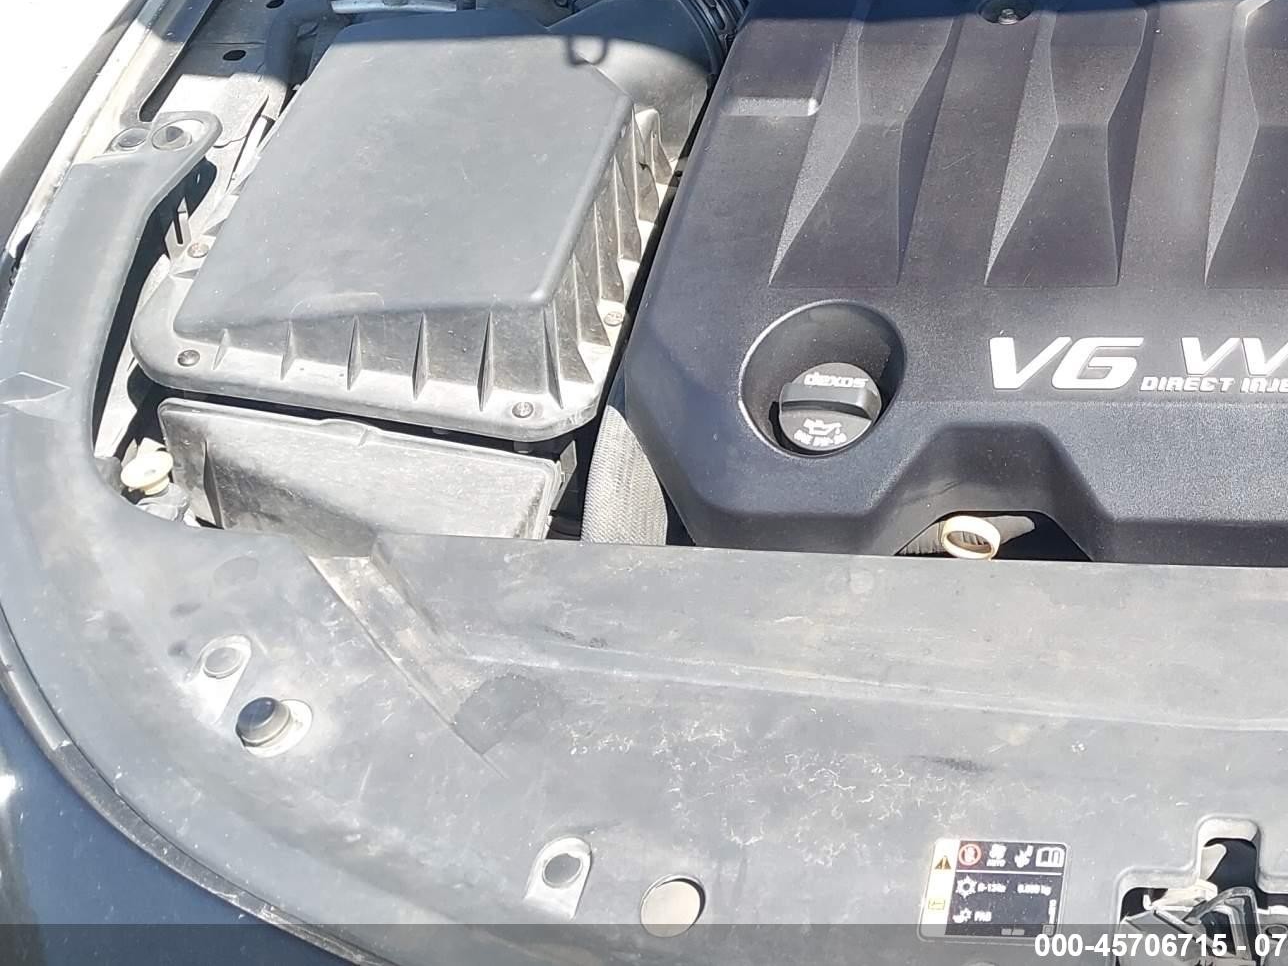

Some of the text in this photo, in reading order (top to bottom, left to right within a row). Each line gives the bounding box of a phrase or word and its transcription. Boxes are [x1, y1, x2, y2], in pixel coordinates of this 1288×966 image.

[989, 336, 1144, 389] V6
[804, 371, 869, 388] dexos
[1140, 376, 1234, 393] DIRECT
